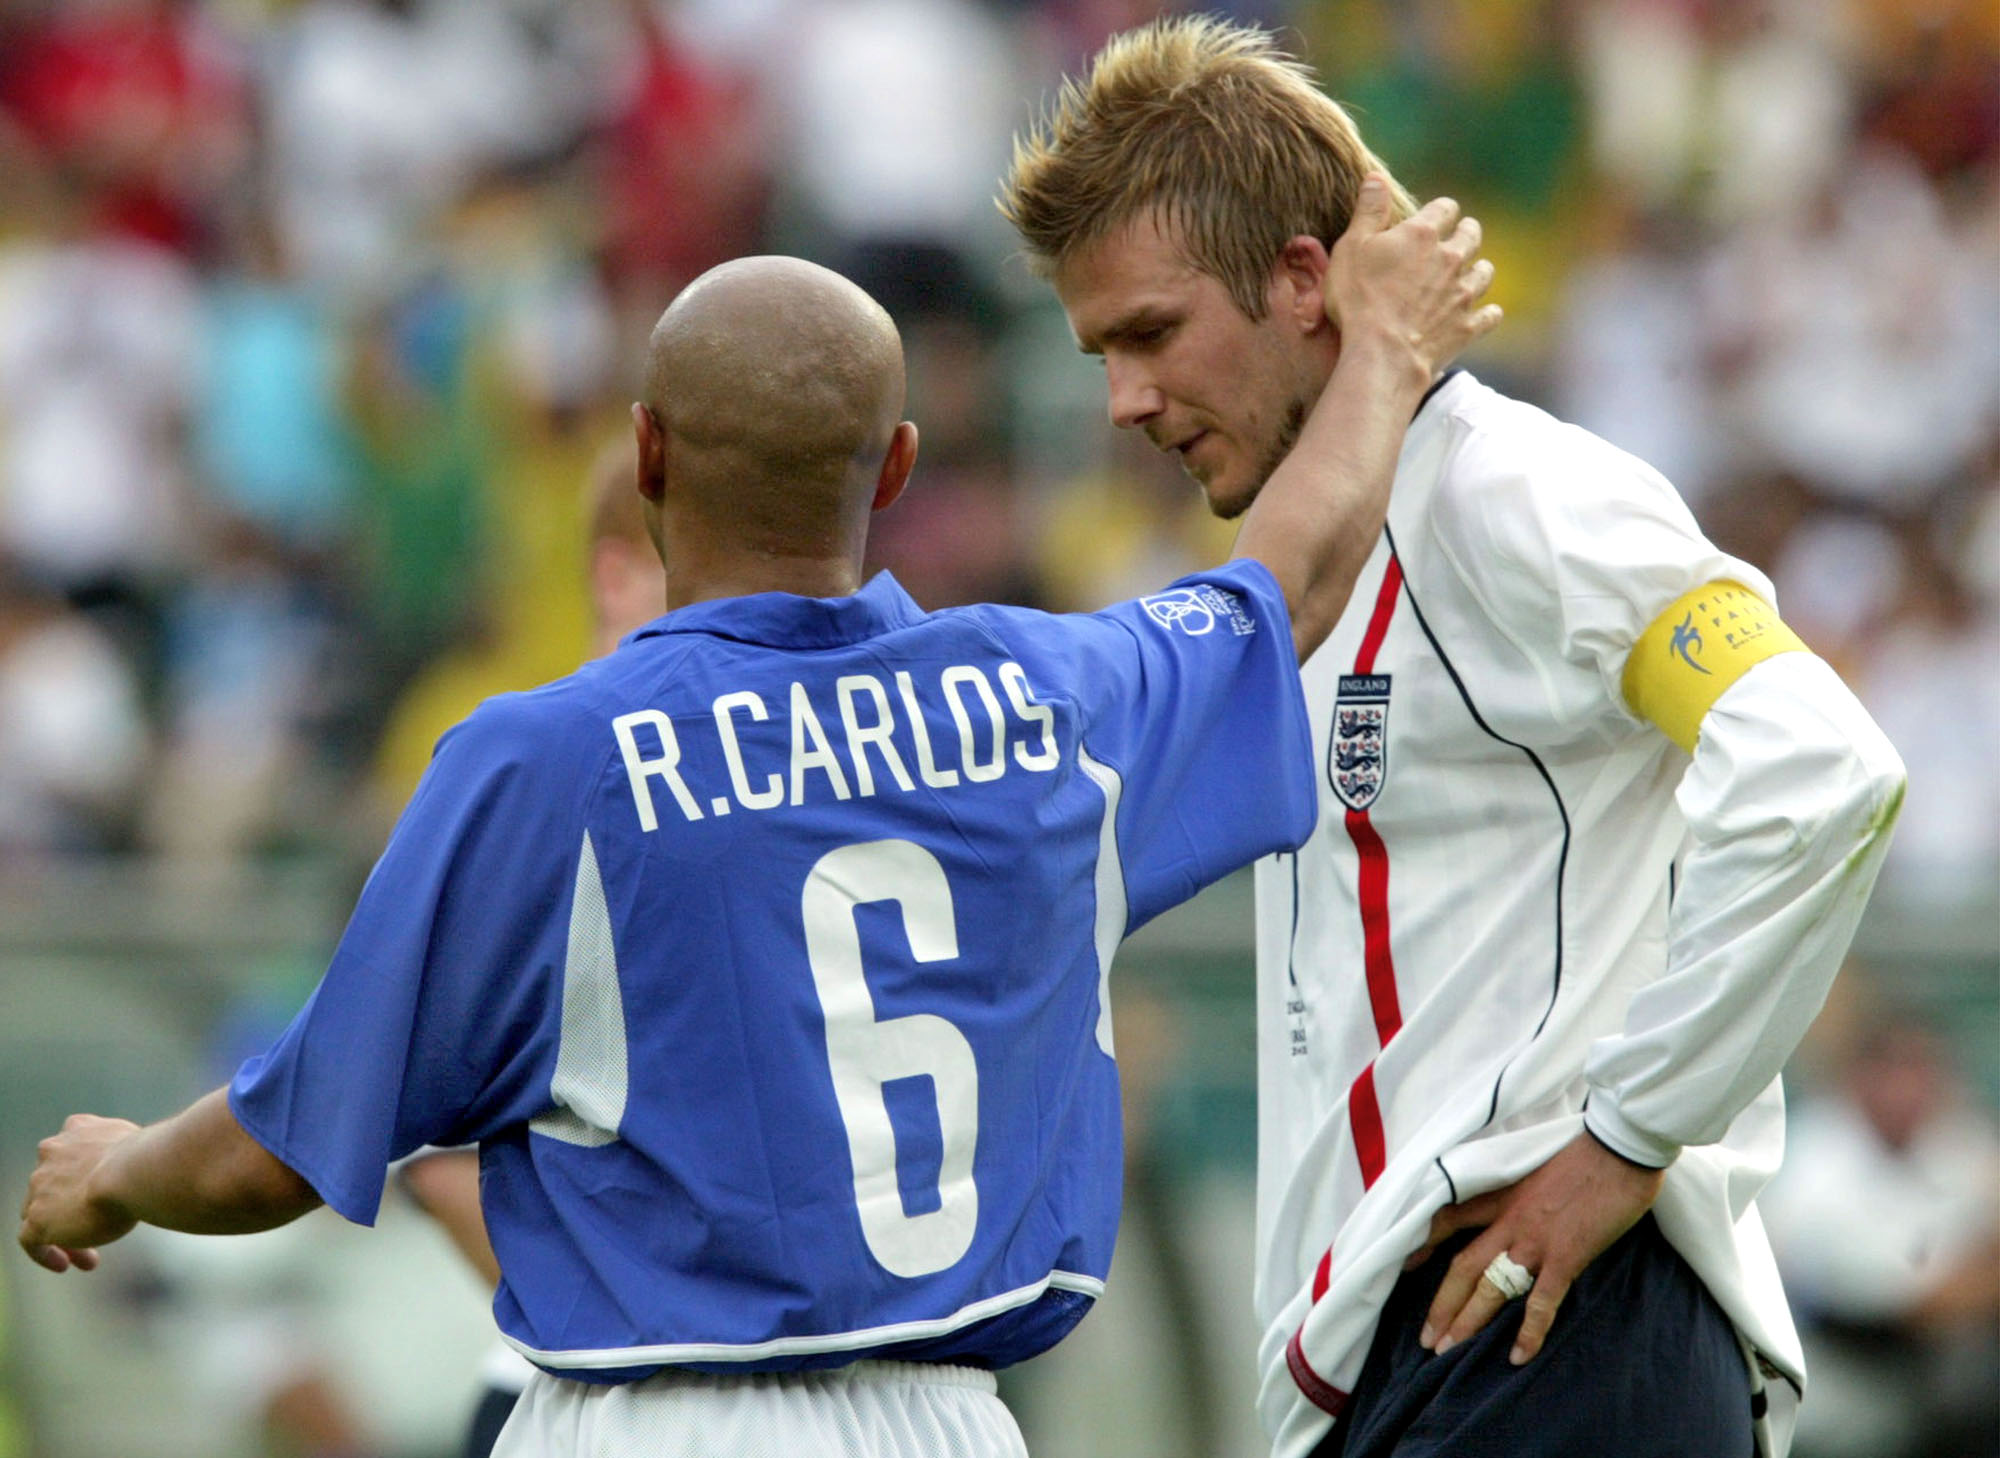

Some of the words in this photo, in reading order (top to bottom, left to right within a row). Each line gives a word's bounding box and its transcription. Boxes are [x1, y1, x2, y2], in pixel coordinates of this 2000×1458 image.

[1725, 620, 1773, 644] PLA
[1341, 679, 1388, 692] ENGLAND
[612, 661, 1061, 833] R.CARLOS
[802, 838, 978, 1278] 6
